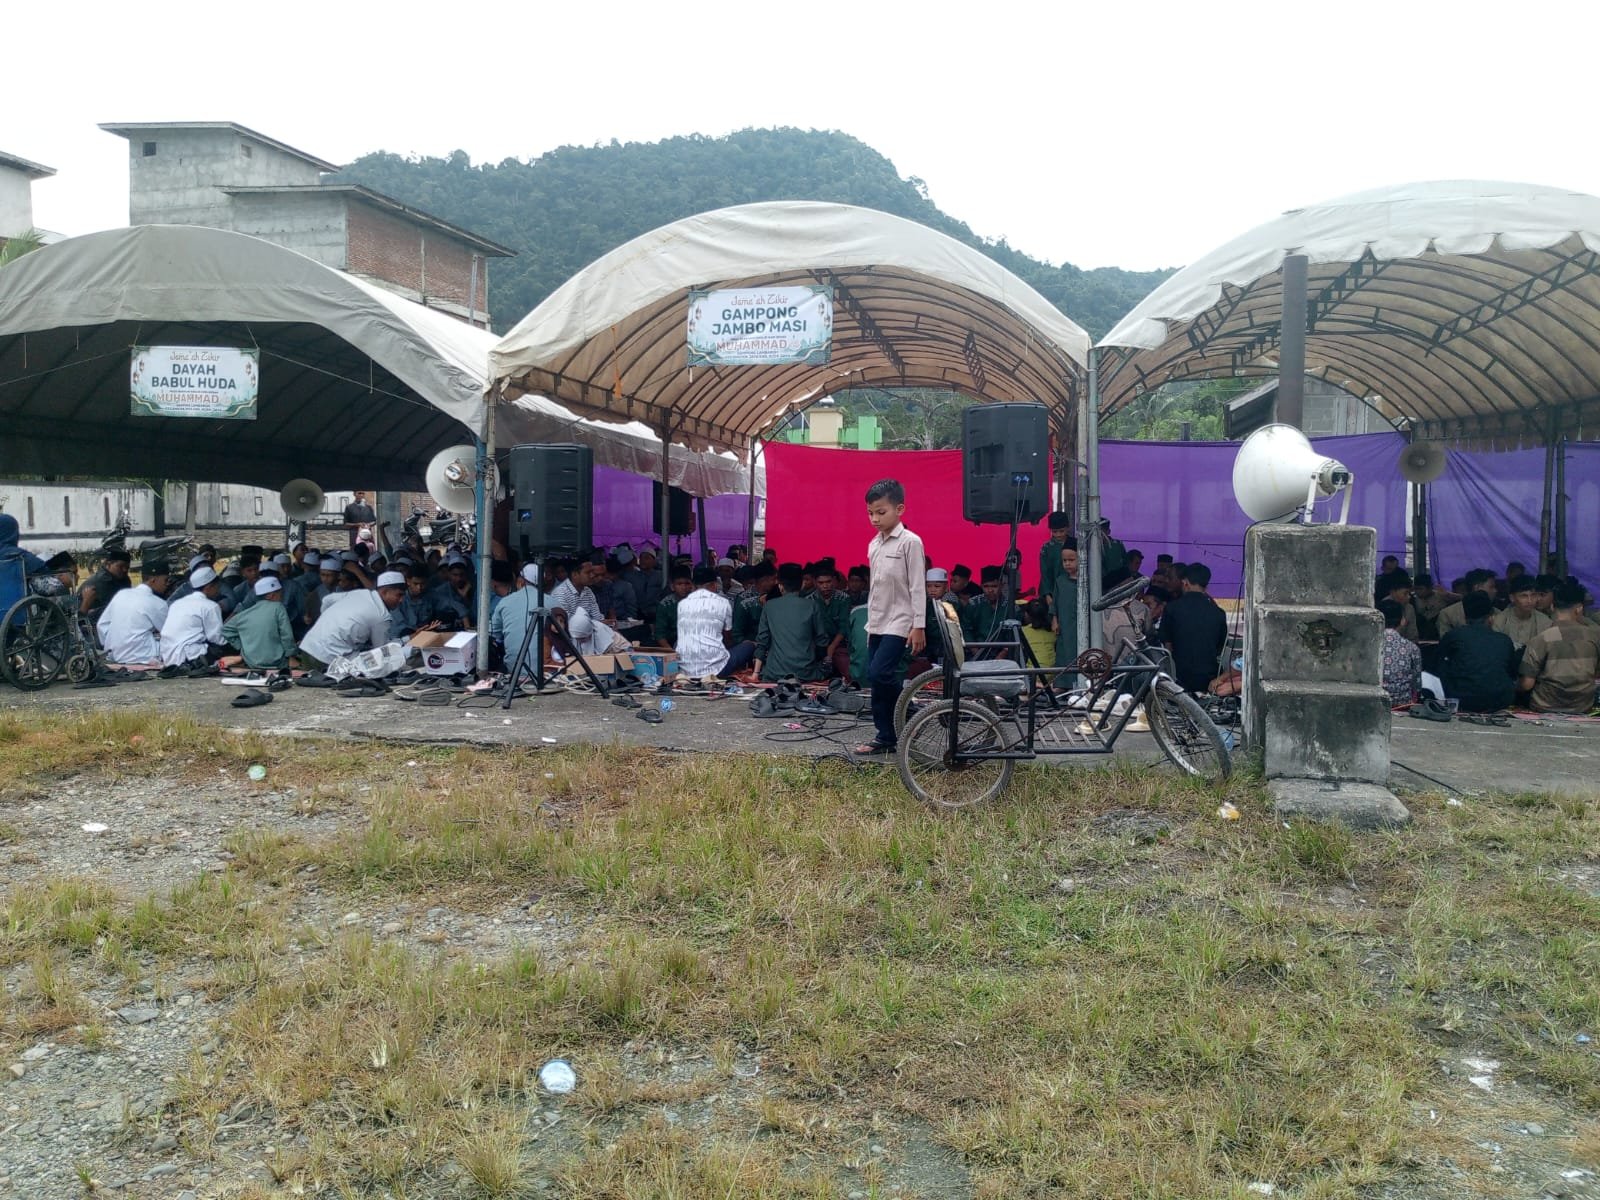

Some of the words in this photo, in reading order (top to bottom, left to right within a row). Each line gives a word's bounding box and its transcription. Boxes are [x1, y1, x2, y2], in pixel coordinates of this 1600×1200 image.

[722, 306, 798, 321] GAMPONG
[712, 322, 766, 336] JAMBO
[769, 320, 807, 333] MASI
[716, 339, 787, 352] MUHAMMAD
[172, 363, 216, 376] DAYAH
[151, 376, 195, 389] BABUL
[198, 378, 237, 390] HUDA
[156, 393, 220, 404] MUHAMMAD
